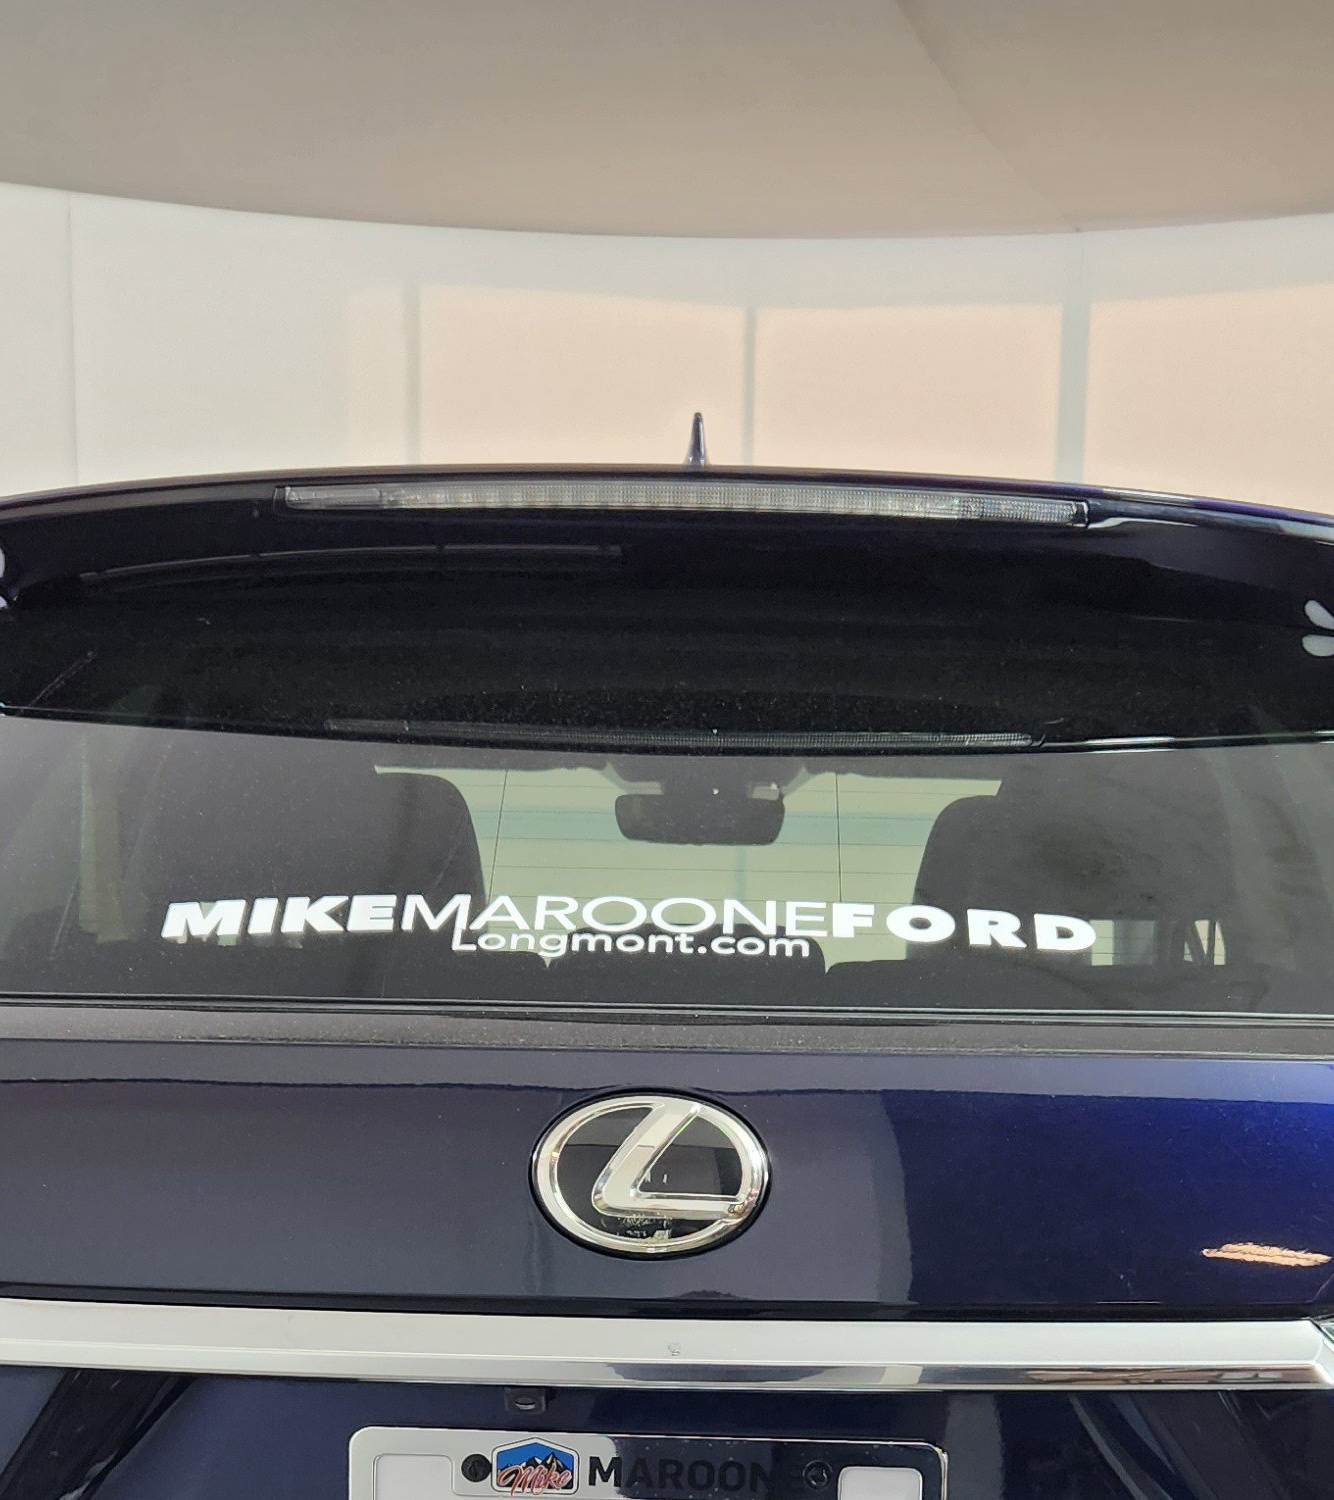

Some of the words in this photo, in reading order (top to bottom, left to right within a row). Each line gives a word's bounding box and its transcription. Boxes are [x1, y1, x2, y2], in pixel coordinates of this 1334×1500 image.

[451, 926, 810, 958] Longmont.com
[496, 1463, 573, 1495] Mike
[589, 1455, 803, 1493] MAROON
